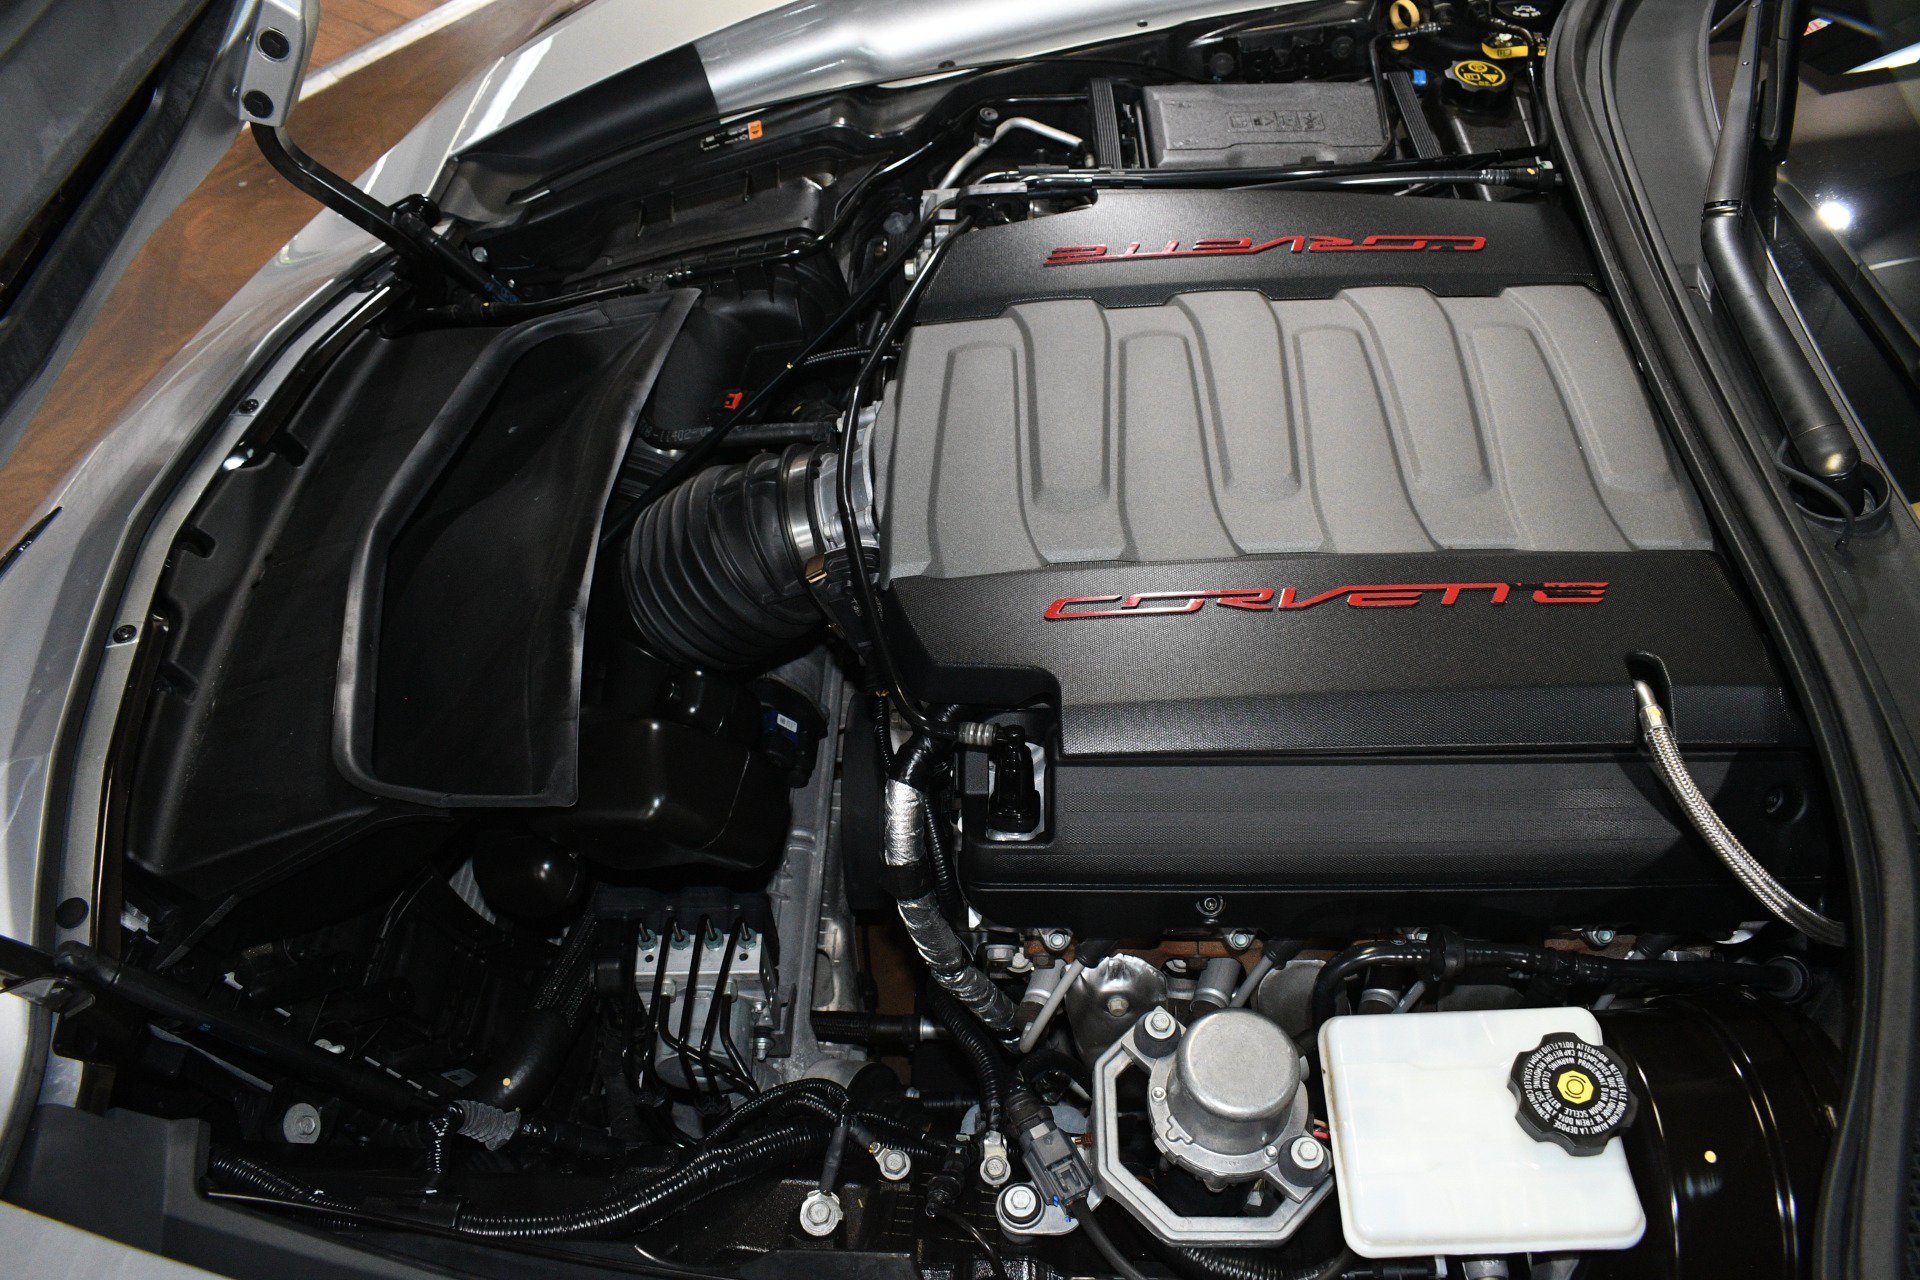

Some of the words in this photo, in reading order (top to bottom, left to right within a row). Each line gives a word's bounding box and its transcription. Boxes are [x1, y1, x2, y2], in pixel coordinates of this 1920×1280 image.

[1043, 235, 1488, 267] CORVETTE
[1043, 581, 1610, 621] CORVETTE
[1540, 1042, 1559, 1055] FLUID
[1557, 1041, 1575, 1049] DOT4
[1529, 1050, 1545, 1066] FROM
[1541, 1050, 1564, 1065] BEFORE
[1564, 1049, 1576, 1057] CAP
[1523, 1067, 1534, 1090] SEALED
[1541, 1070, 1552, 1089] CLEAN
[1577, 1058, 1609, 1086] PROVENANT
[1608, 1063, 1628, 1093] NETTOYER
[1607, 1076, 1618, 1088] QUE
[1535, 1091, 1547, 1103] USE
[1543, 1090, 1562, 1110] FILLER
[1609, 1089, 1619, 1099] DU
[1618, 1093, 1628, 1102] LE
[1541, 1101, 1558, 1116] ONLY
[1588, 1100, 1607, 1116] BIDON
[1601, 1098, 1618, 1119] LIQUIDE
[1607, 1101, 1627, 1126] BOUCHON
[1557, 1113, 1574, 1125] DOT4
[1575, 1117, 1595, 1127] FREIN
[1593, 1114, 1604, 1124] DE
[1579, 1126, 1590, 1135] LA
[1590, 1122, 1610, 1135] AVANT
